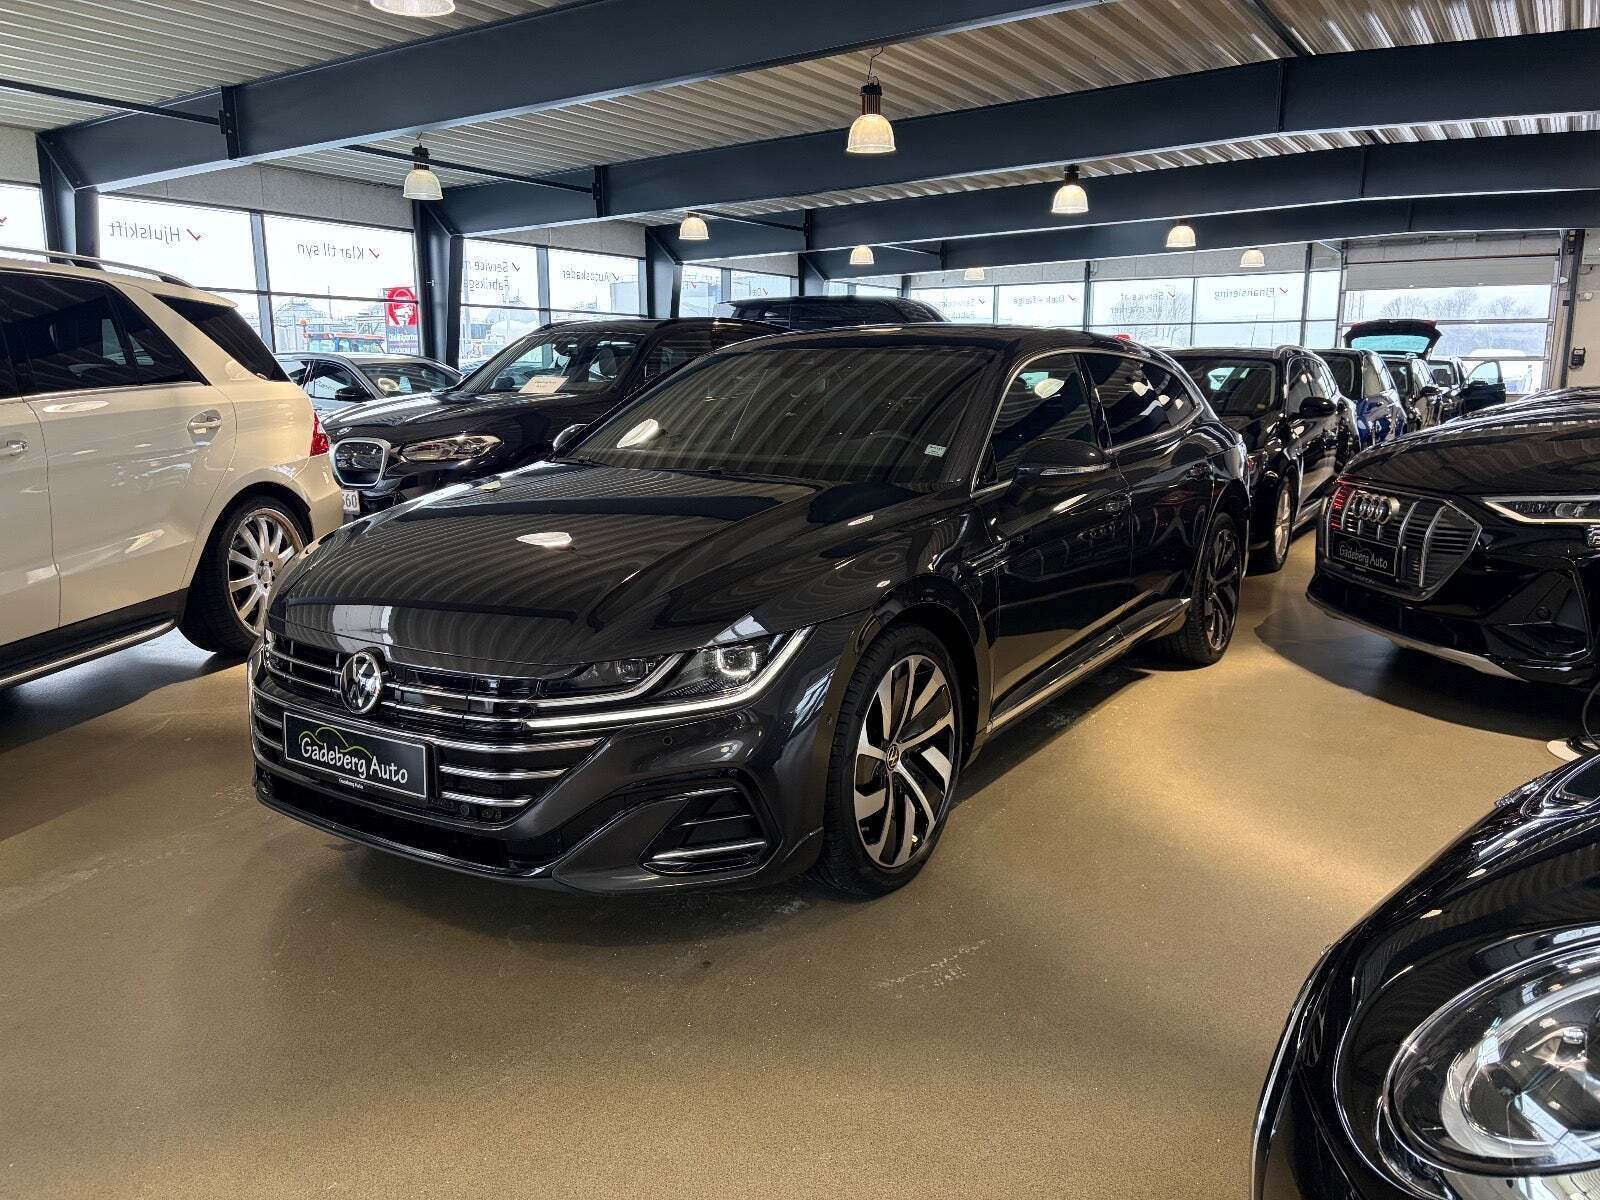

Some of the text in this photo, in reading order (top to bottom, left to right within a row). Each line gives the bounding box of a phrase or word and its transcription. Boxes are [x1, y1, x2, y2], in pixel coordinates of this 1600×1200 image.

[1340, 544, 1388, 569] Gadeberg Auto
[301, 737, 408, 784] Gadeberg Auto
